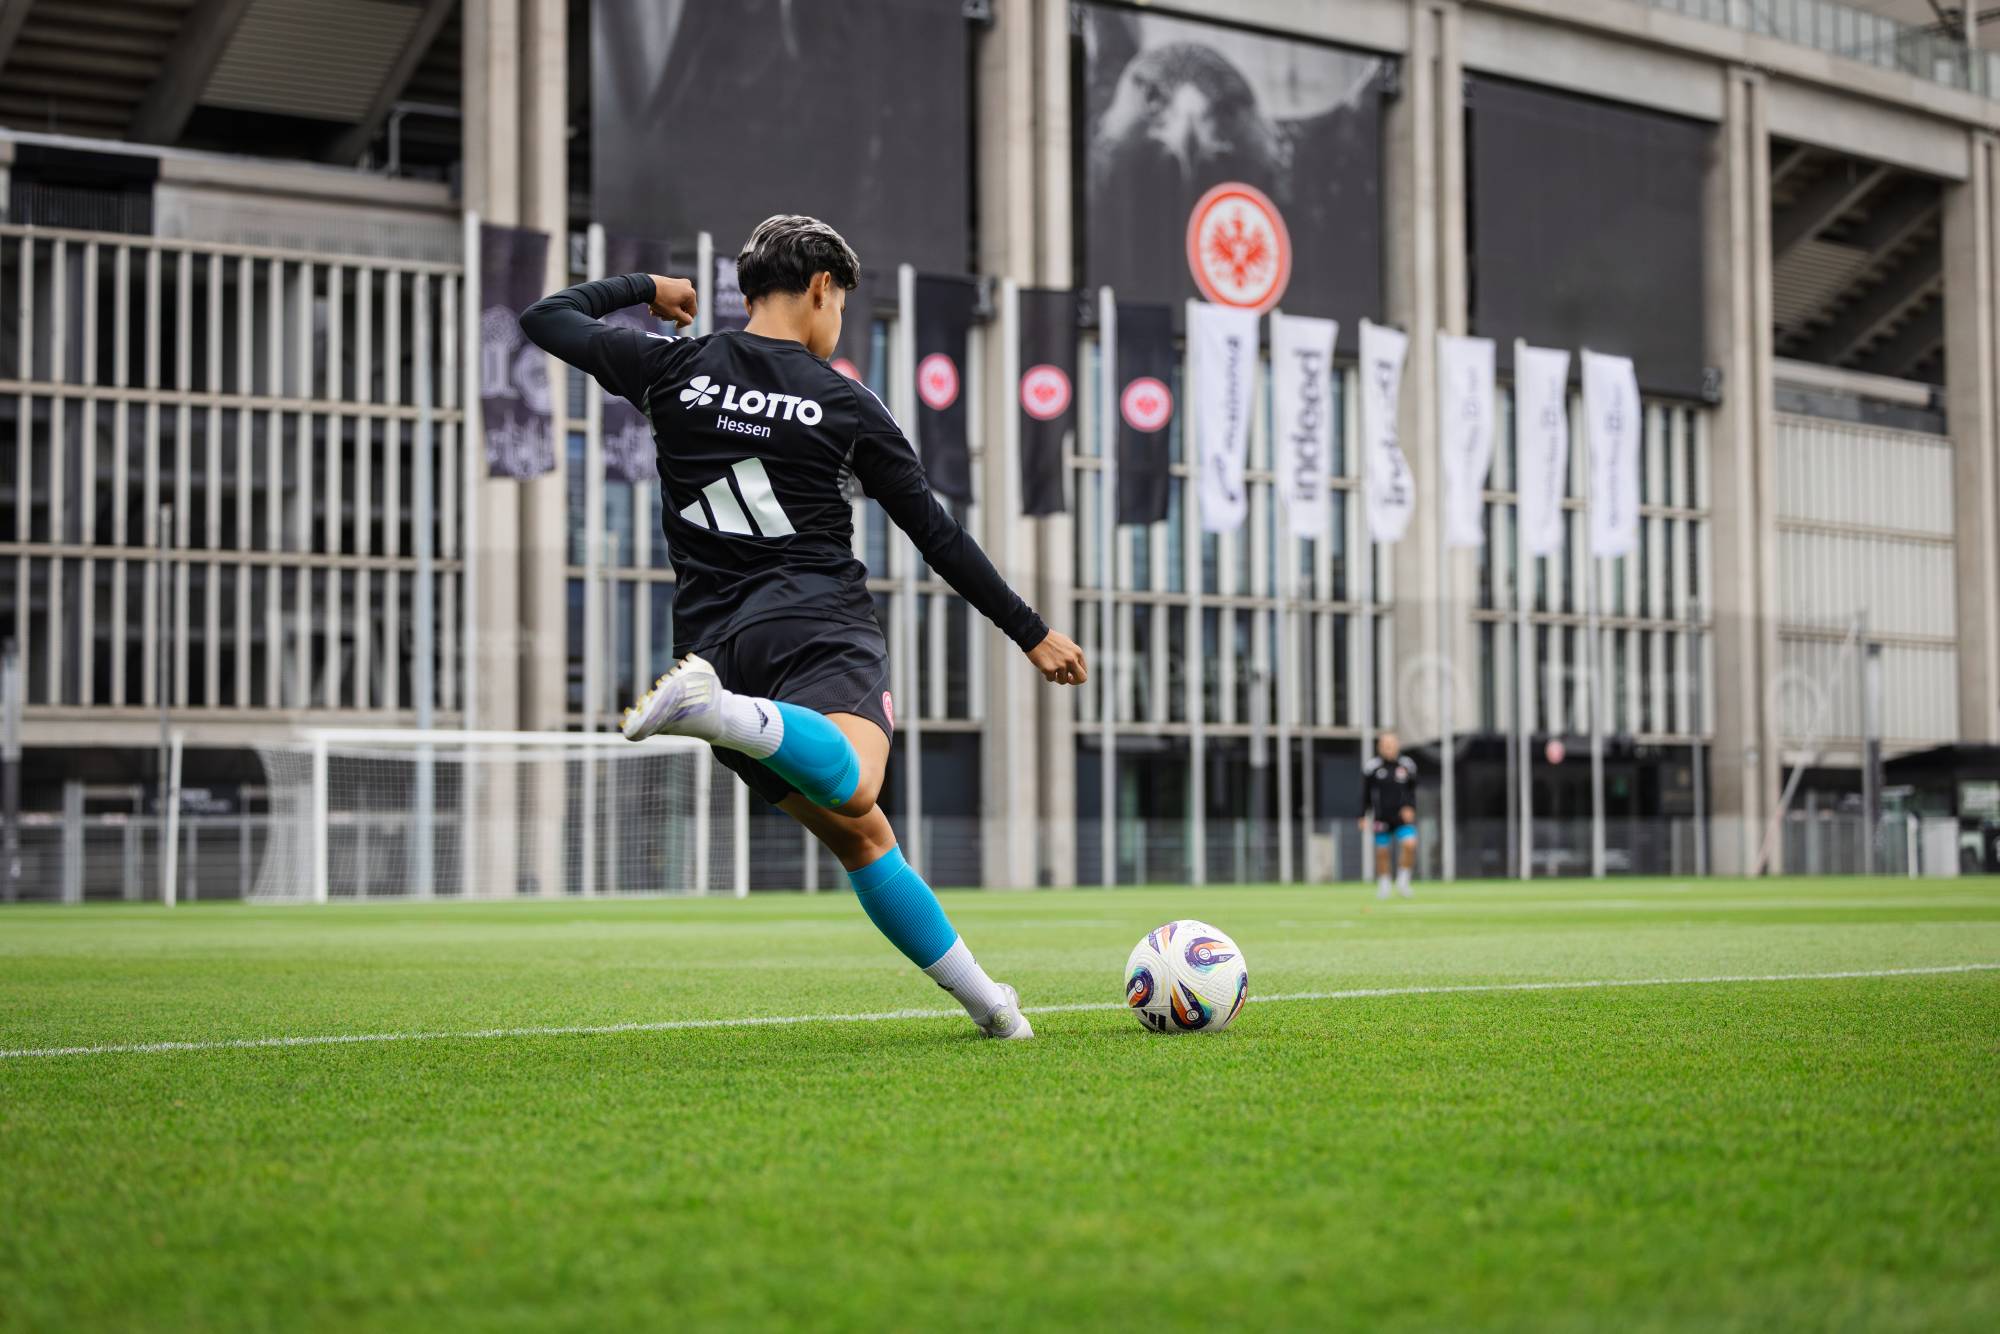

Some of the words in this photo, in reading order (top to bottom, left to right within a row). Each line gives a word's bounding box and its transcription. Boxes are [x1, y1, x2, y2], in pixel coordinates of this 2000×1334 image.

[716, 414, 771, 438] Hessen
[721, 384, 823, 426] LOTTO
[1292, 347, 1324, 502] indeed
[1372, 358, 1408, 507] indd
